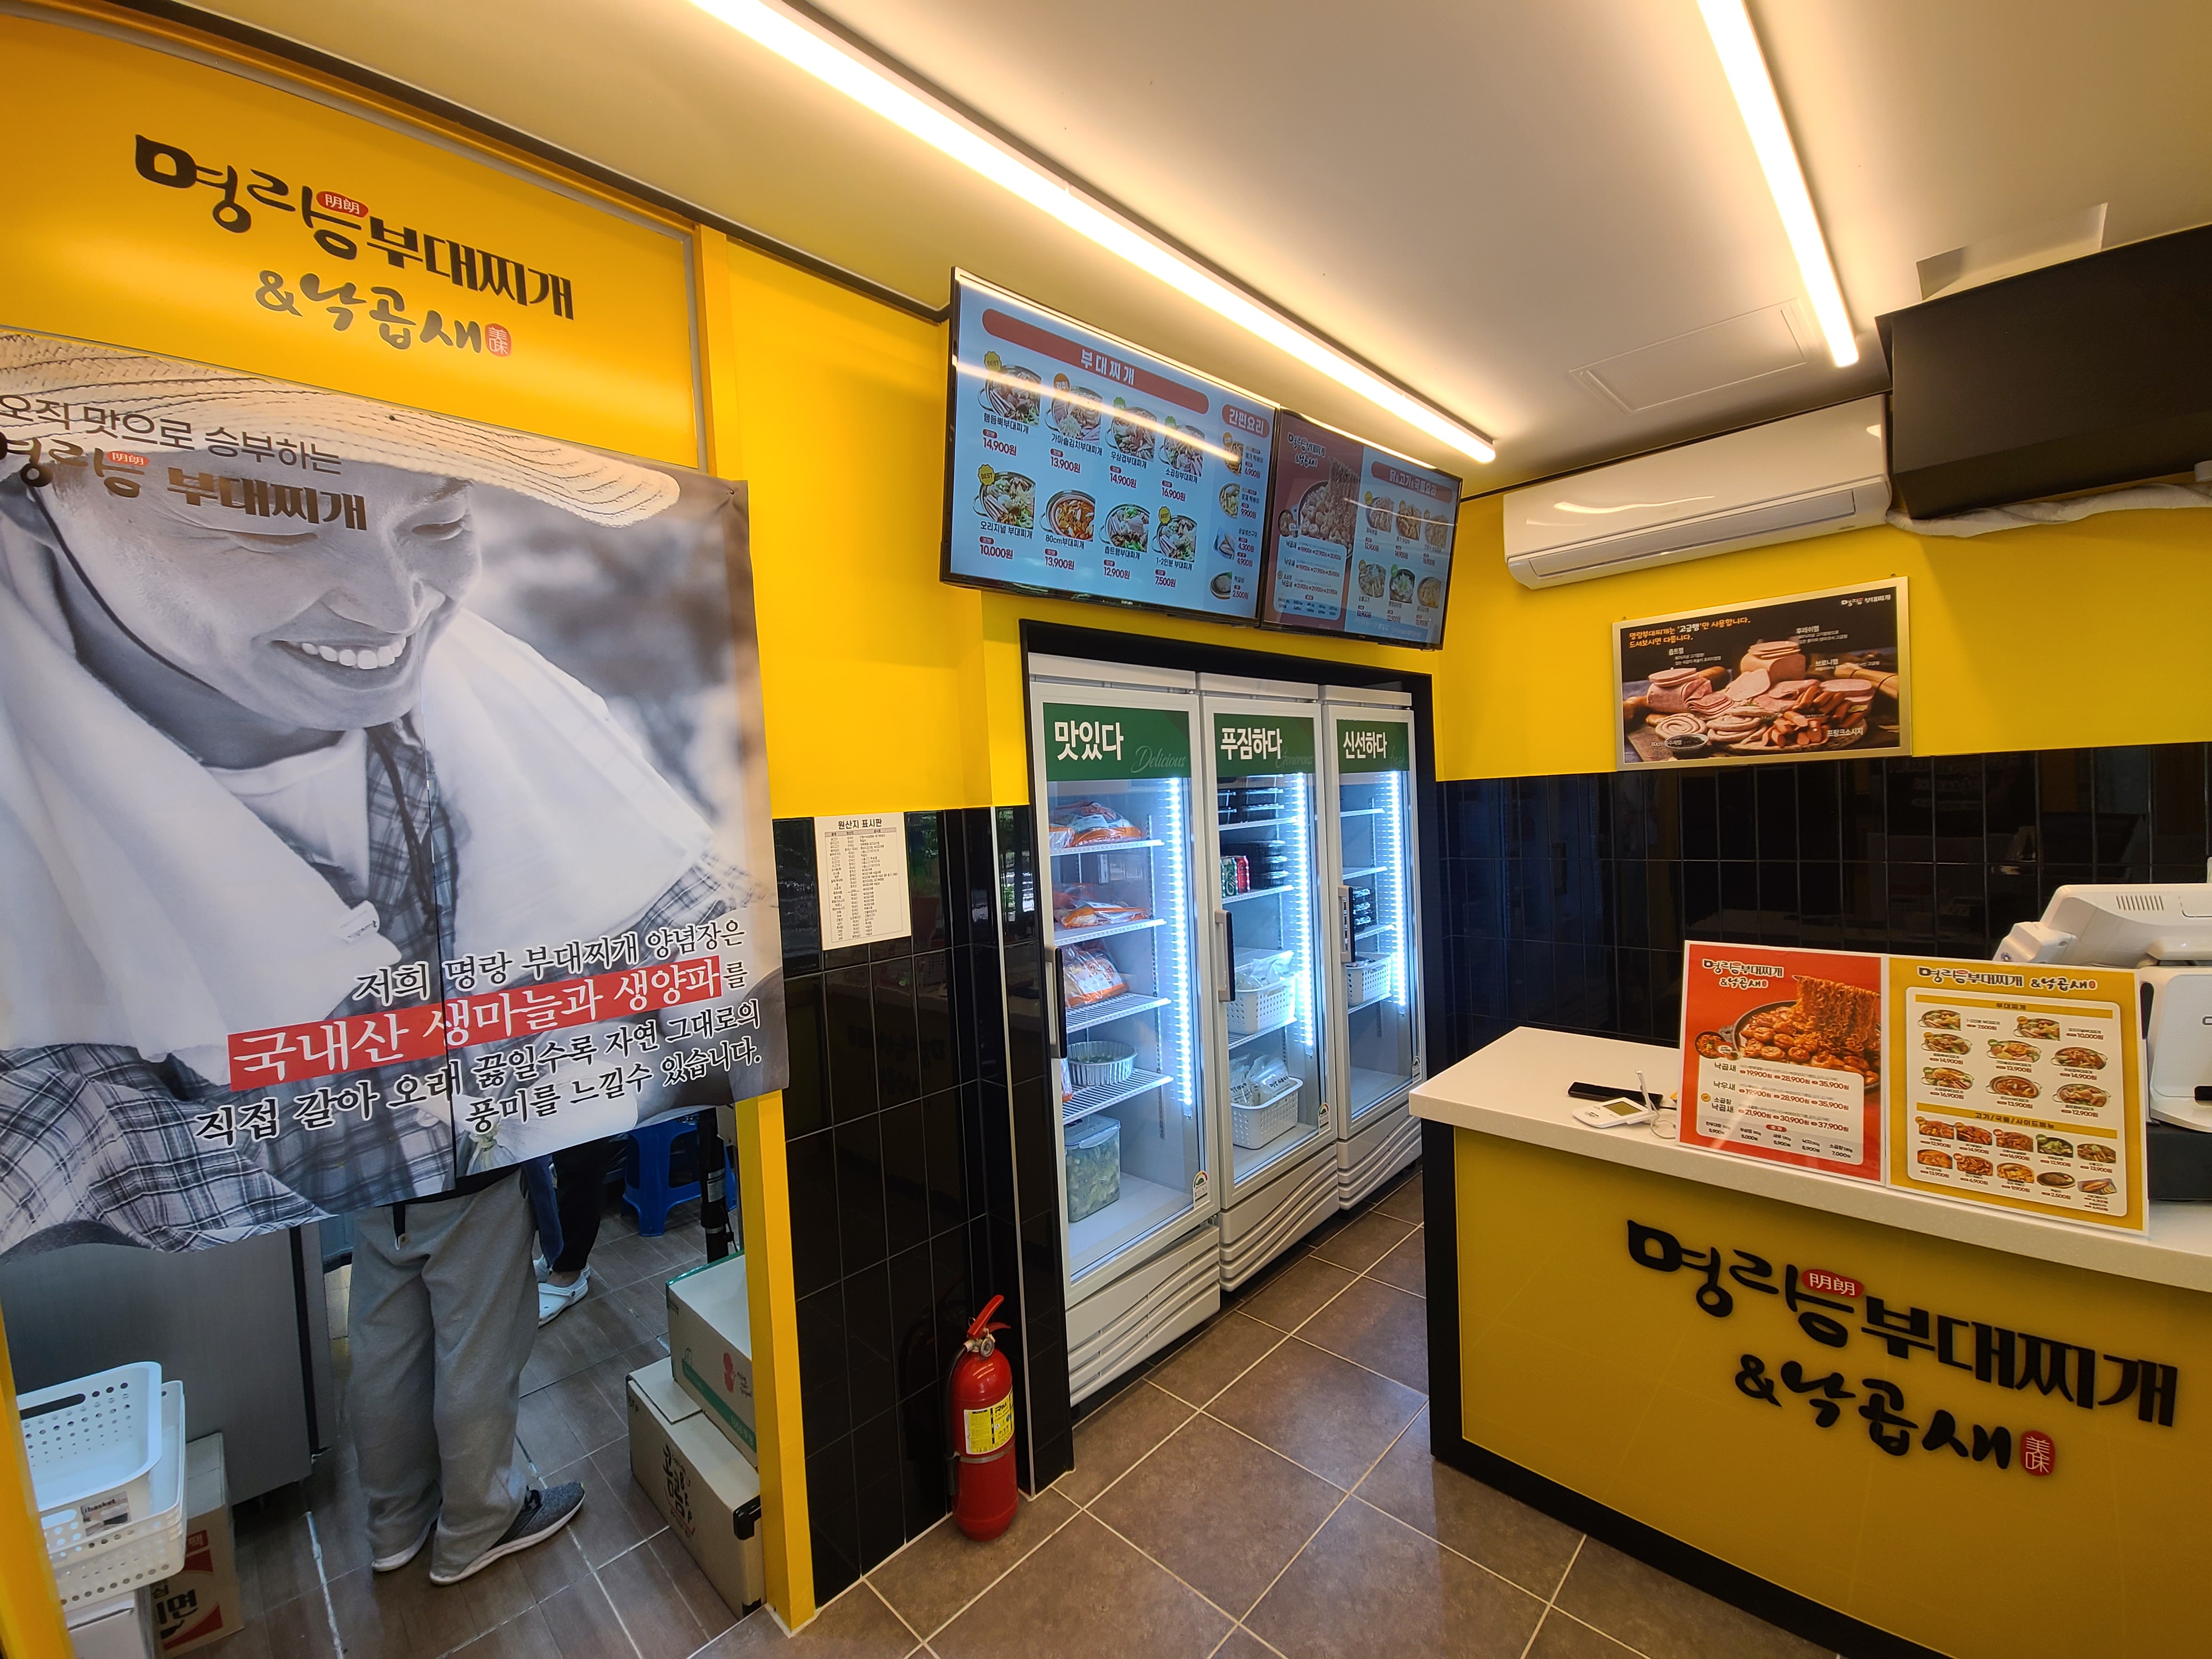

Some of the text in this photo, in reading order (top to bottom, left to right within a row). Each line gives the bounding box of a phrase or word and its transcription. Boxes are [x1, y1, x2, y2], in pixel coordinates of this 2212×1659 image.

[1229, 408, 1264, 435] 간편요리
[0, 394, 342, 475] 오직 맛으로 승부하는
[983, 437, 1016, 456] 14,900원
[1051, 457, 1080, 474] 13,900원
[1110, 472, 1136, 488] 14,900원
[168, 467, 367, 530] 부대찌개
[1162, 487, 1186, 502] 16,900원
[980, 521, 1032, 540] 오리지널 부대찌개
[1046, 534, 1084, 549] 80cm부대찌개
[980, 545, 1013, 560] 10,000원
[1045, 556, 1074, 570] 13,900원
[1156, 557, 1173, 567] 1-2인분
[1104, 567, 1130, 580] 12,900원
[1155, 576, 1176, 587] 7,500원
[1629, 627, 1676, 640] 명랑부대찌개는
[1711, 617, 1751, 628] 사용합니다.
[1663, 634, 1693, 644] 다릅니다.
[1054, 721, 1124, 761] 맛있다
[1827, 727, 1864, 737] 프랑크소시지
[1221, 727, 1282, 760] 푸짐하다
[1343, 731, 1387, 760] 신선하다
[1131, 745, 1187, 774] Delicious
[838, 818, 882, 830] 원산지 표시판
[353, 919, 745, 1006] 저희 명랑 부대찌개 양념장은
[232, 958, 747, 1082] 국내산 생마늘과 생양파 를
[195, 999, 761, 1145] 직접 갈아 오래 끓일수록 자연 그대로의
[1714, 1062, 1736, 1072] 낙곱새
[1747, 1070, 1772, 1078] 19,900원
[1781, 1075, 1810, 1084] 28,900원
[1819, 1081, 1849, 1090] 35,900원
[466, 1037, 762, 1136] 풍미를 느낄수 있습니다.
[1713, 1081, 1735, 1091] 낙우새
[1746, 1089, 1771, 1098] 19,900원
[1781, 1094, 1809, 1104] 28,900원
[1818, 1100, 1849, 1110] 35,900원
[1712, 1103, 1734, 1113] 낙곱새
[1745, 1109, 1771, 1119] 21,900원
[1780, 1115, 1809, 1125] 30,900원
[1818, 1121, 1849, 1132] 37,900원
[85, 1499, 116, 1513] ibasket
